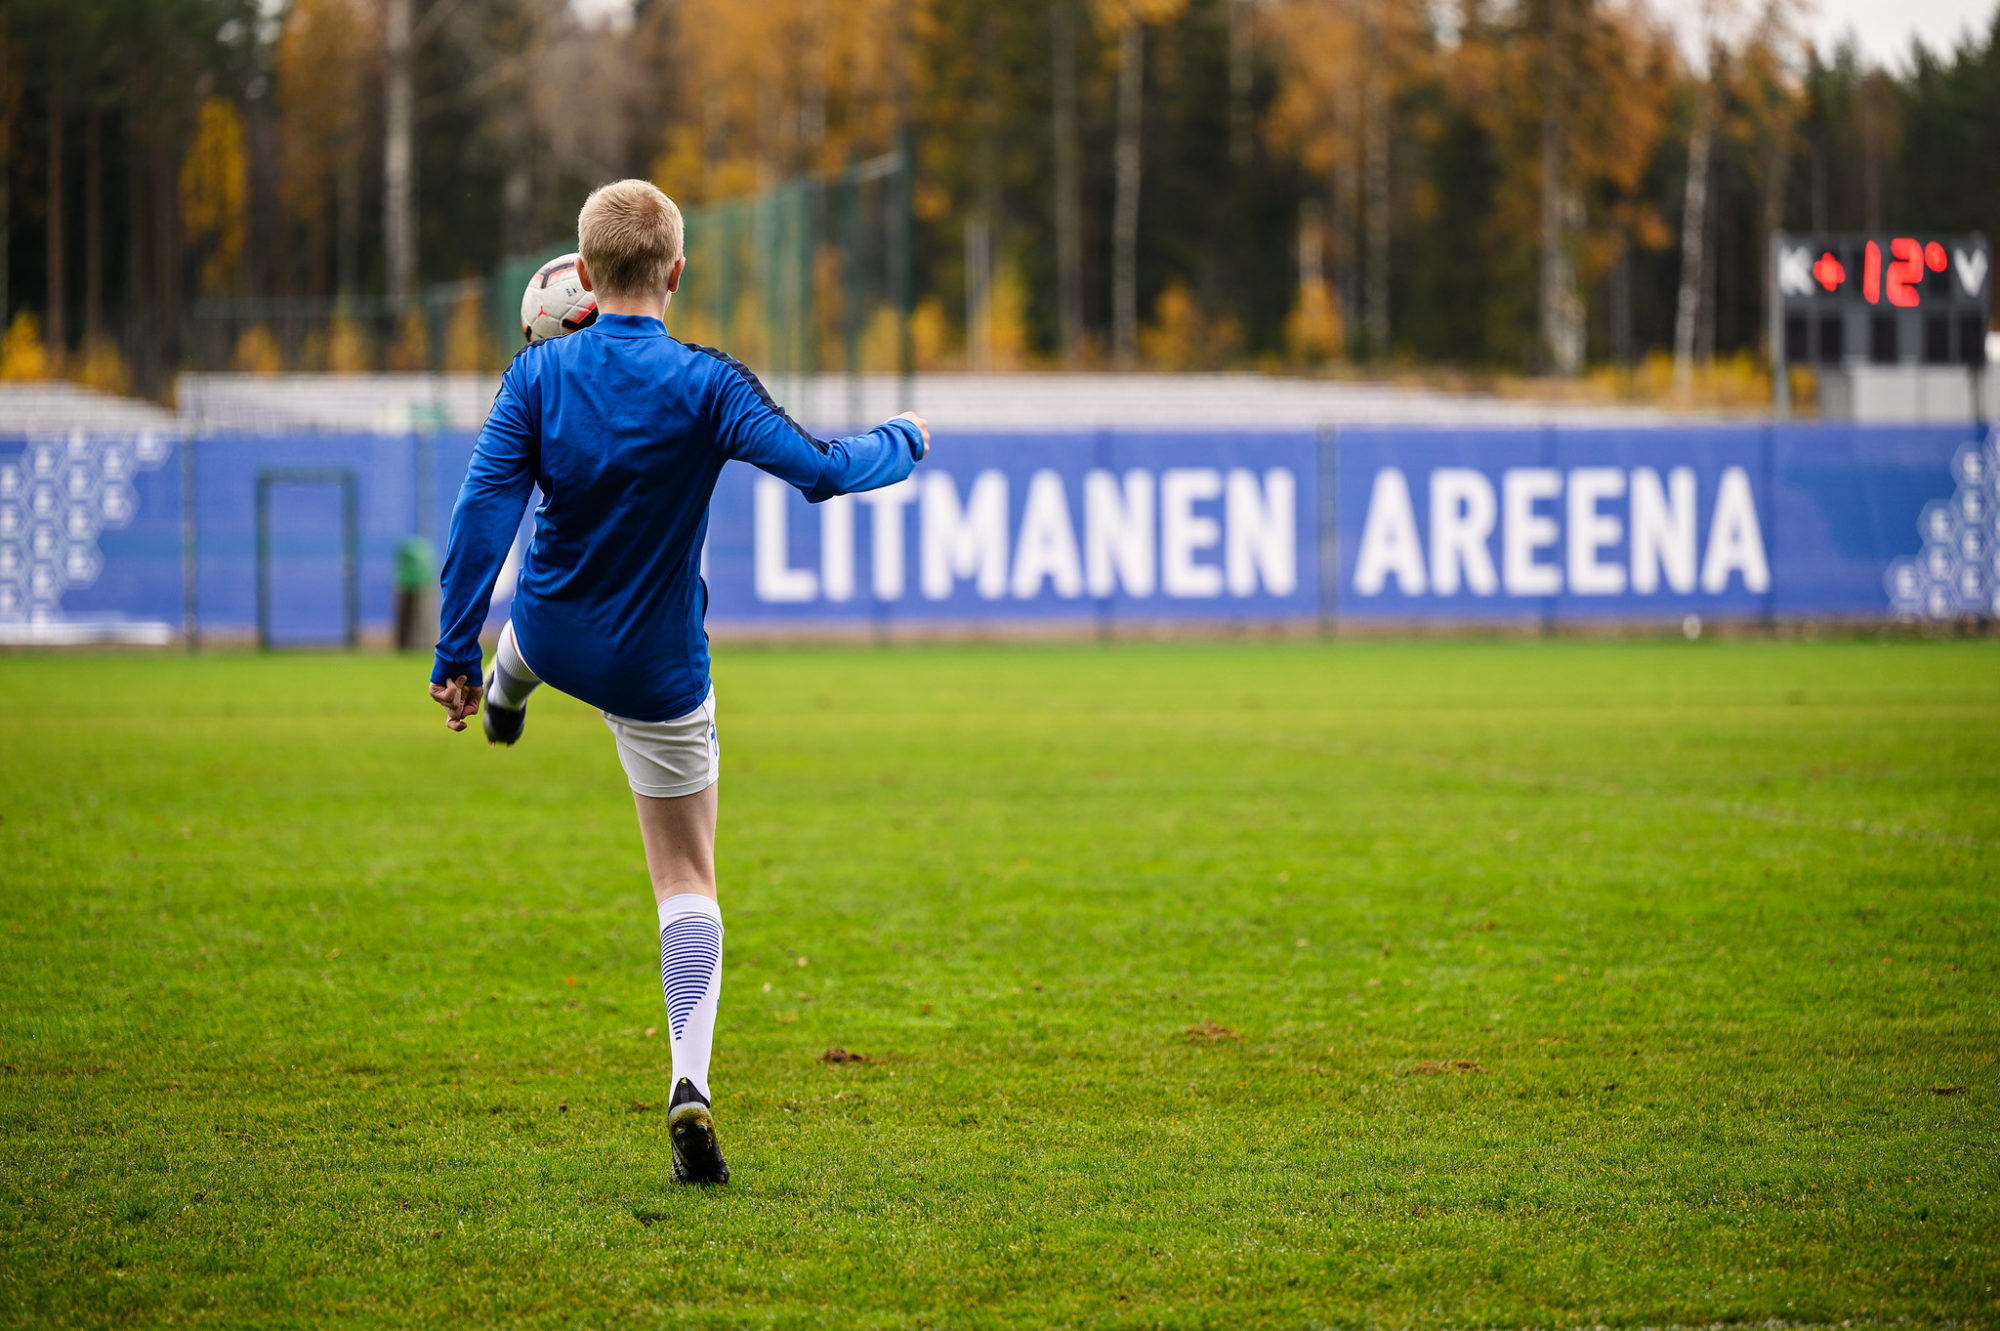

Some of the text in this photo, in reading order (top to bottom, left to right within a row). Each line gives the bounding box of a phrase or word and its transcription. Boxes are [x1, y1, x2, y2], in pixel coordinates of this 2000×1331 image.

[1777, 246, 1815, 297] K
[1954, 247, 1989, 297] V
[754, 467, 1297, 603] LITMANEN
[1353, 465, 1771, 598] AREENA
